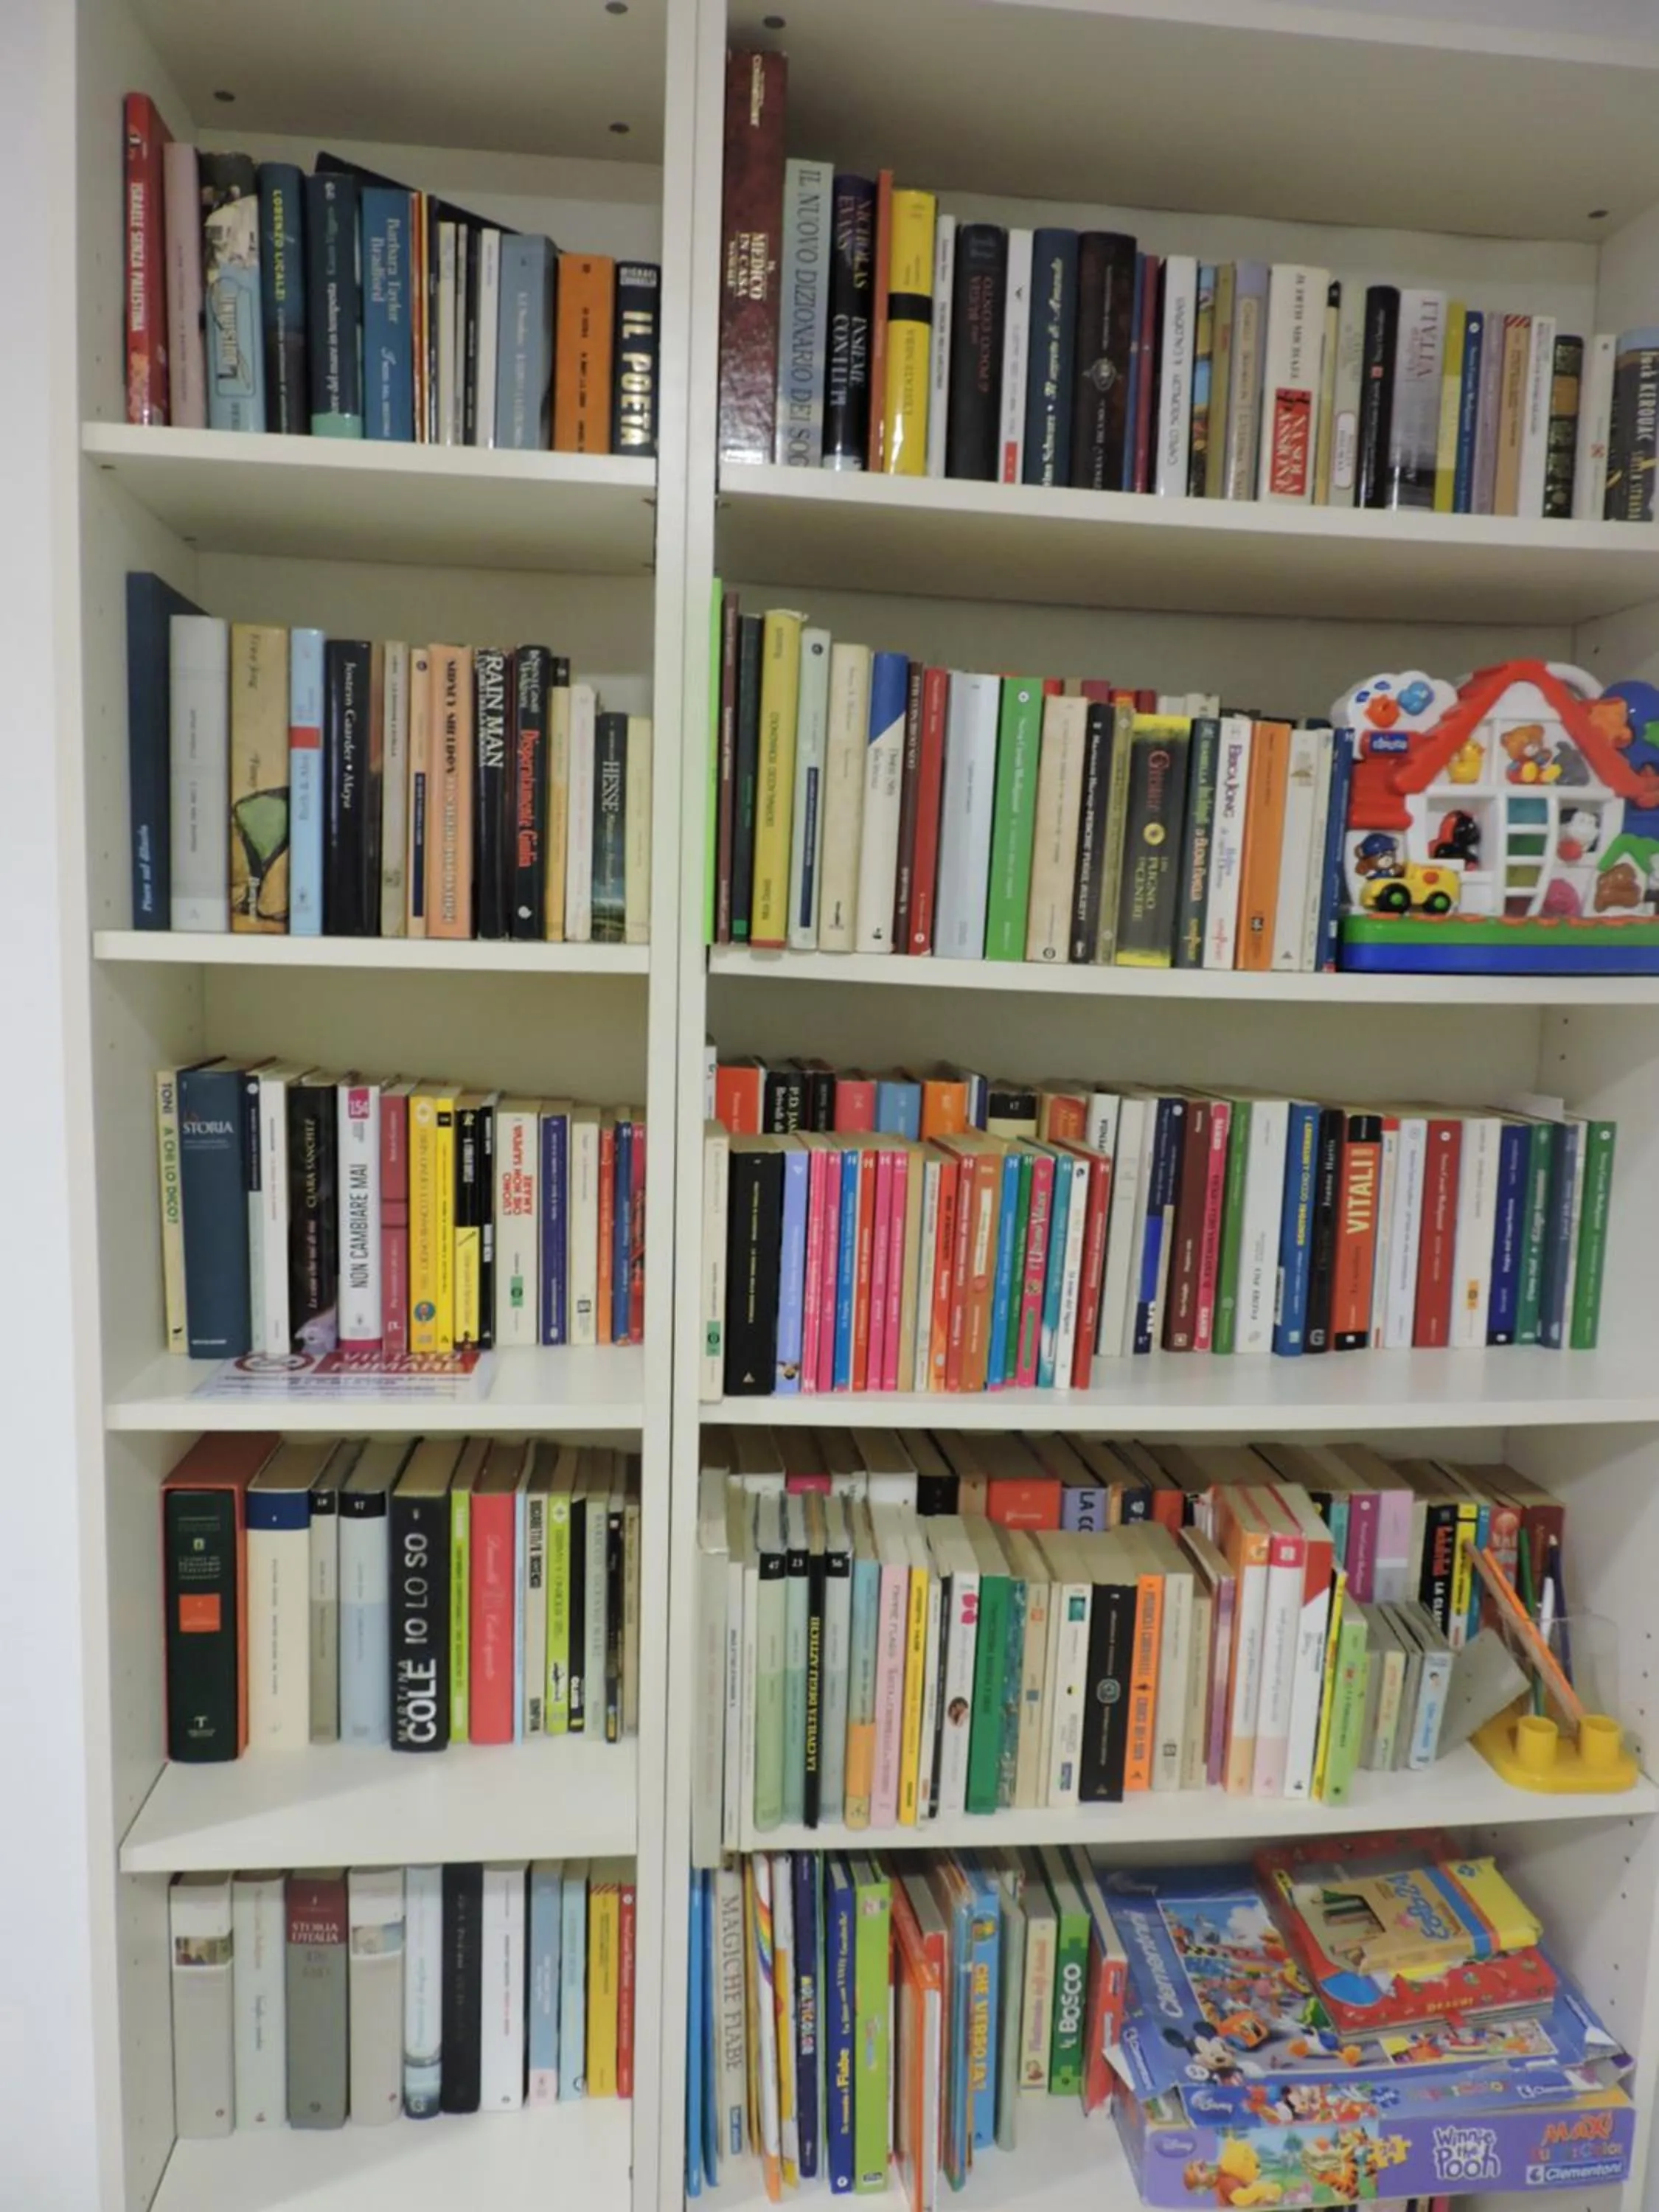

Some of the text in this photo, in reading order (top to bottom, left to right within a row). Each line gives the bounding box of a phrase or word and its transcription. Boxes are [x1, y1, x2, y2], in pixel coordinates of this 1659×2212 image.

[272, 189, 285, 248] LORENZO
[853, 199, 871, 289] NICHOLAS
[370, 237, 385, 302] Bradford
[386, 218, 401, 324] Barbara Taylor
[737, 255, 748, 297] CASA
[749, 232, 766, 300] MEDICO
[789, 169, 821, 421] IL NUOVO DIZIONARIO DEI
[849, 316, 868, 388] INSIEME
[1416, 300, 1439, 378] VITALI
[621, 311, 653, 445] IL POETA
[1635, 351, 1658, 441] Jack KEROUAC
[341, 661, 356, 809] Jostein Gaarder Maya
[486, 656, 504, 768] RAIN MAN
[518, 729, 539, 827] Disperatamente
[602, 761, 619, 813] HESSE
[1222, 744, 1243, 818] ERICA JONG
[1146, 856, 1158, 910] PUGNO
[161, 1082, 173, 1114] TONI
[183, 1121, 234, 1135] STORIA
[164, 1140, 175, 1162] CHI
[164, 1165, 176, 1182] LO
[513, 1125, 523, 1216] CHE NON SAPEVA
[1322, 1139, 1335, 1206] Joanne Harris
[165, 1186, 178, 1225] DICO?
[305, 1172, 318, 1208] CLARA
[501, 1172, 512, 1216] L'UOMO
[523, 1175, 533, 1216] AMARE
[1346, 1161, 1374, 1234] VITALI
[349, 1163, 369, 1288] NON CAMBIARE MAI
[1080, 1491, 1096, 1511] LA
[404, 1533, 427, 1644] IO LO SO
[406, 1658, 437, 1743] COLE
[806, 1755, 815, 1772] LA
[292, 1922, 338, 1932] STORIA
[721, 1894, 743, 2073] MAGICHE FIABE
[973, 1962, 989, 1997] CHE
[1061, 1962, 1081, 2034] BOSCO
[799, 1975, 815, 2056] MULTICOLOR
[973, 2000, 988, 2058] VERSO
[1433, 2125, 1498, 2149] Winnie
[1434, 2149, 1502, 2181] Pooh
[1455, 2142, 1481, 2161] the
[1543, 2162, 1623, 2183] Clementoni
